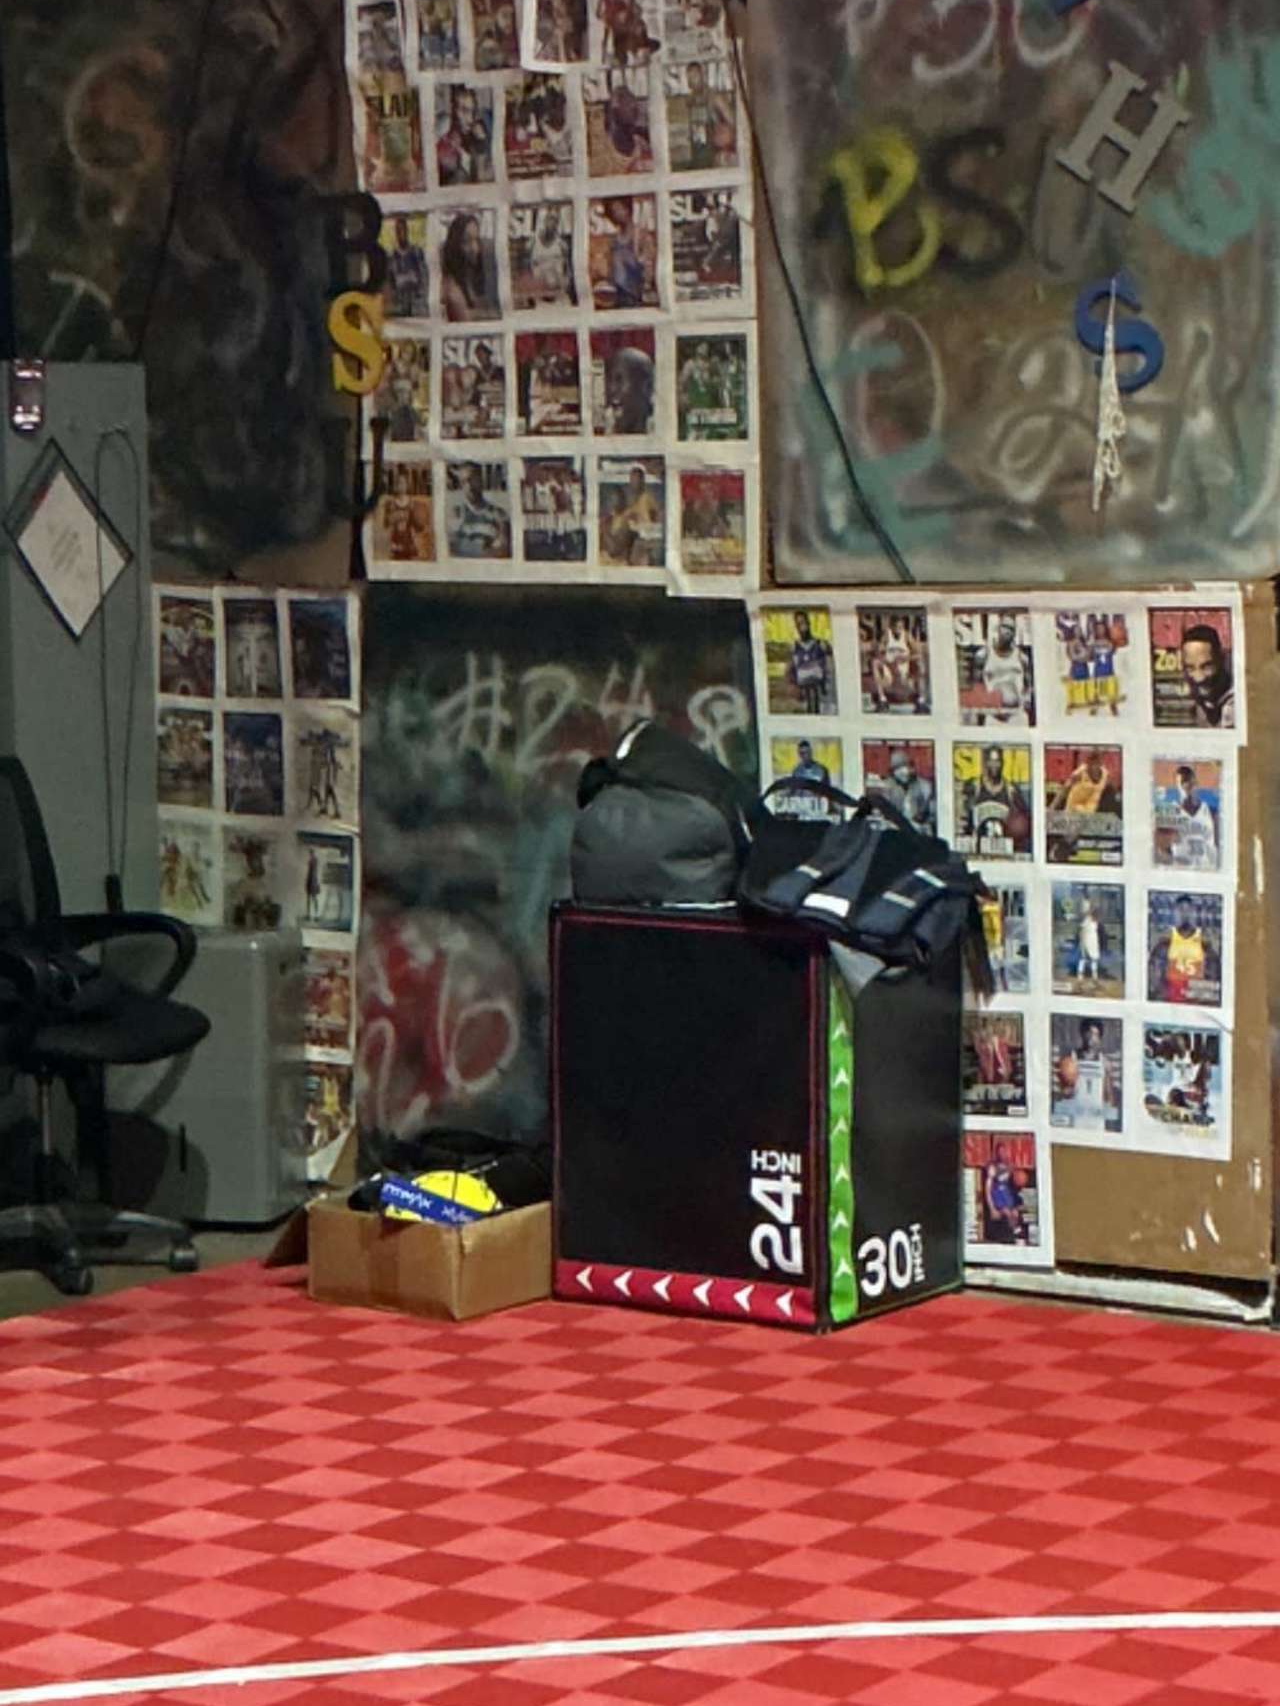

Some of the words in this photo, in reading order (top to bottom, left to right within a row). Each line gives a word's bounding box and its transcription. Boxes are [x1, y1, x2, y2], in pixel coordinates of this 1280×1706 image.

[1056, 60, 1192, 215] H
[751, 1150, 802, 1175] INCH
[750, 1175, 803, 1275] 24
[857, 1228, 912, 1297] 30
